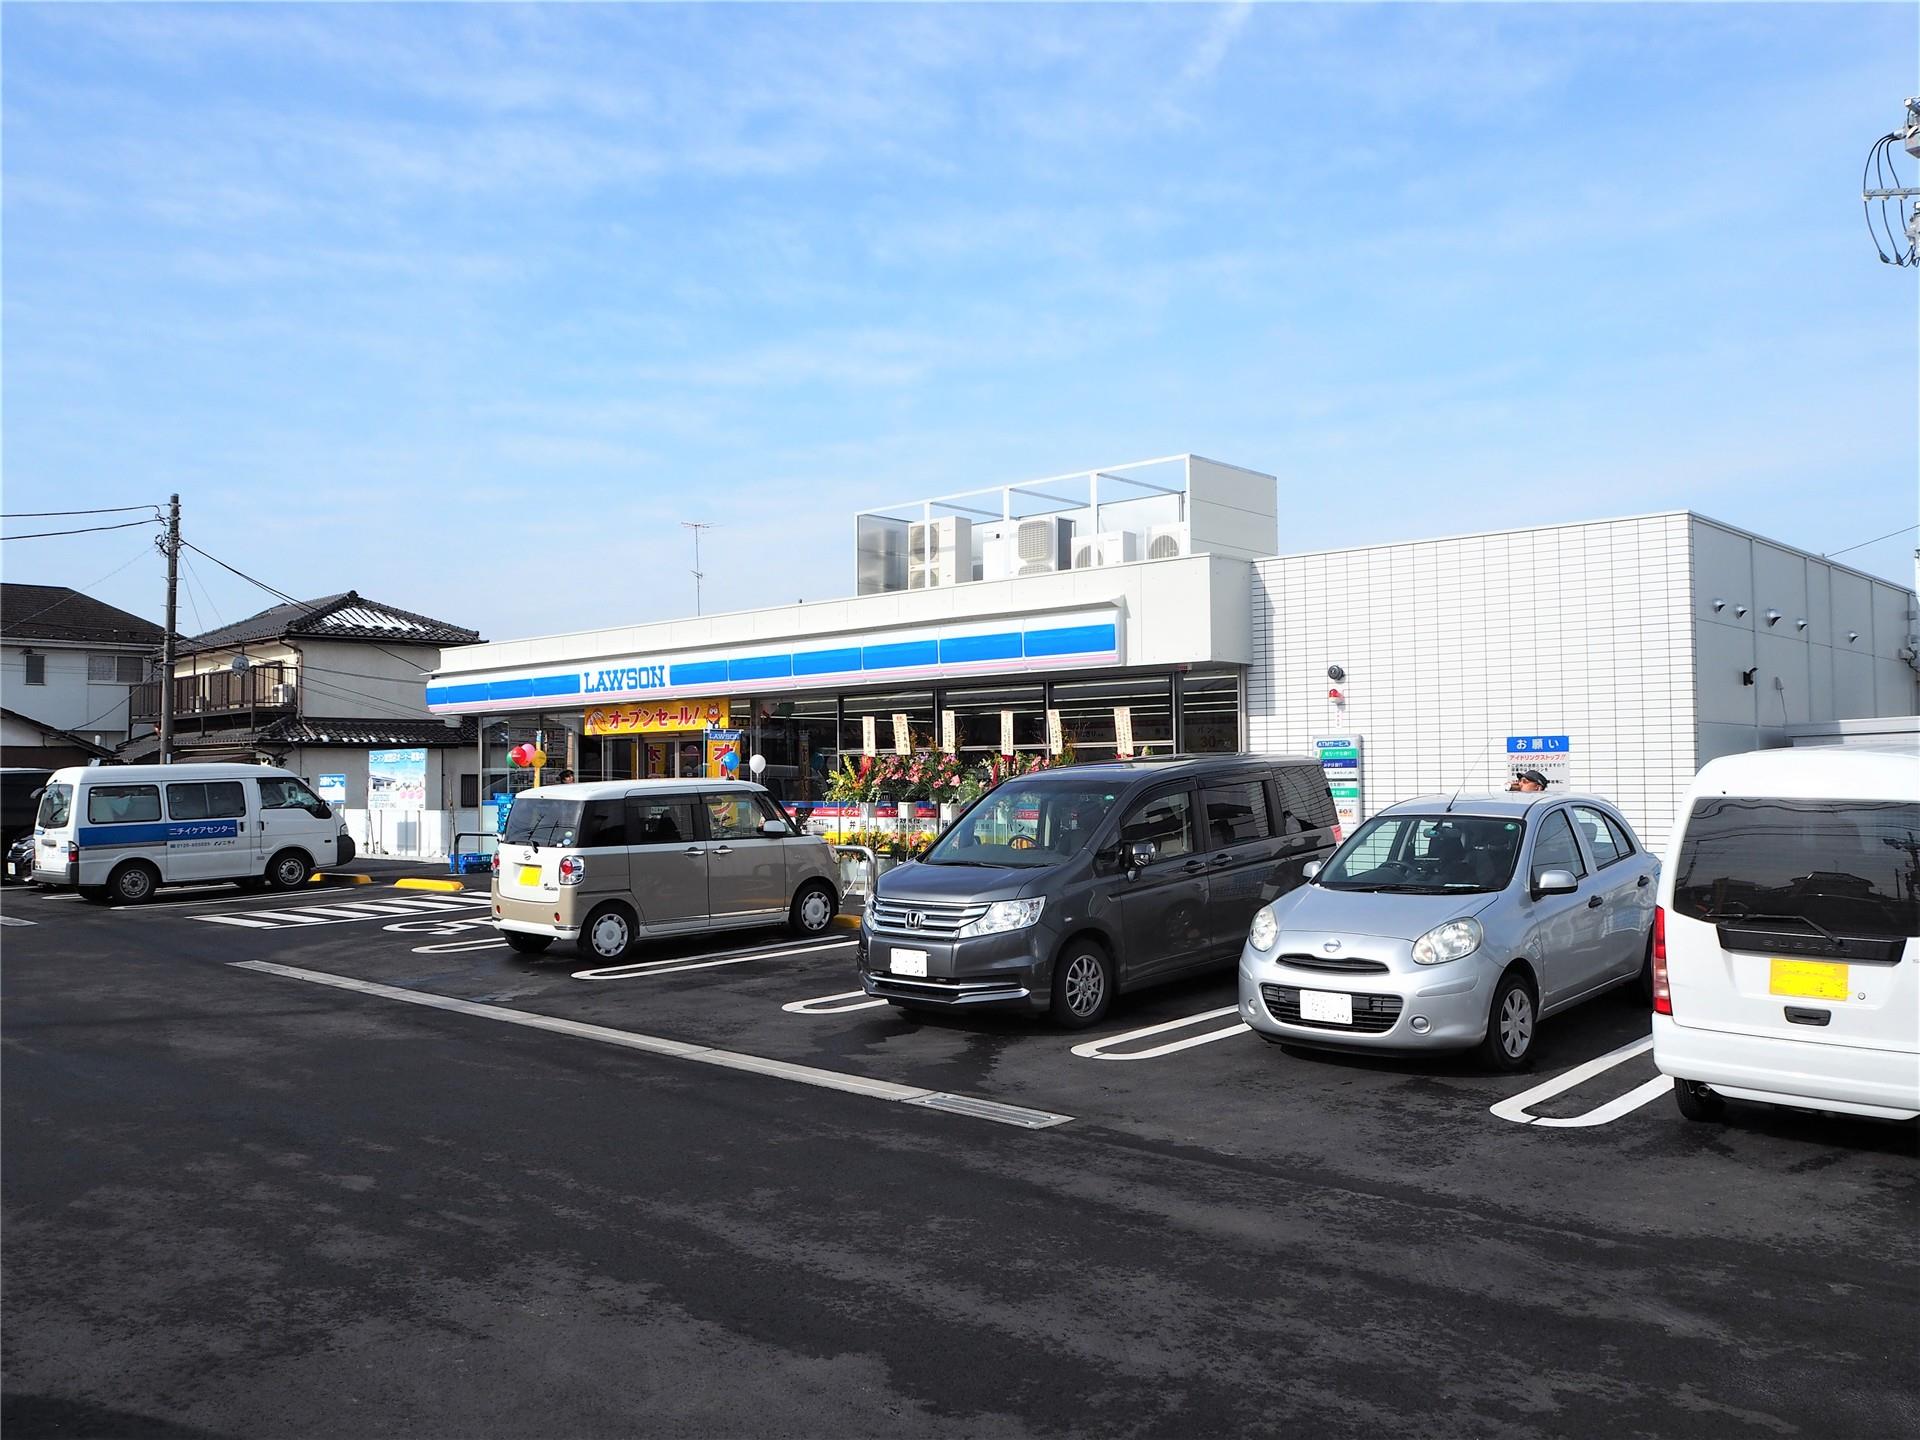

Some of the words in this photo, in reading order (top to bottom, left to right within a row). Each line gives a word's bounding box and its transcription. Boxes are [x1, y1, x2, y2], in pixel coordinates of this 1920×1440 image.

[584, 665, 665, 693] LAWSON
[609, 706, 700, 729] オープンセール!
[1516, 738, 1560, 750] お願い
[169, 825, 236, 836] ニチイケアセンター
